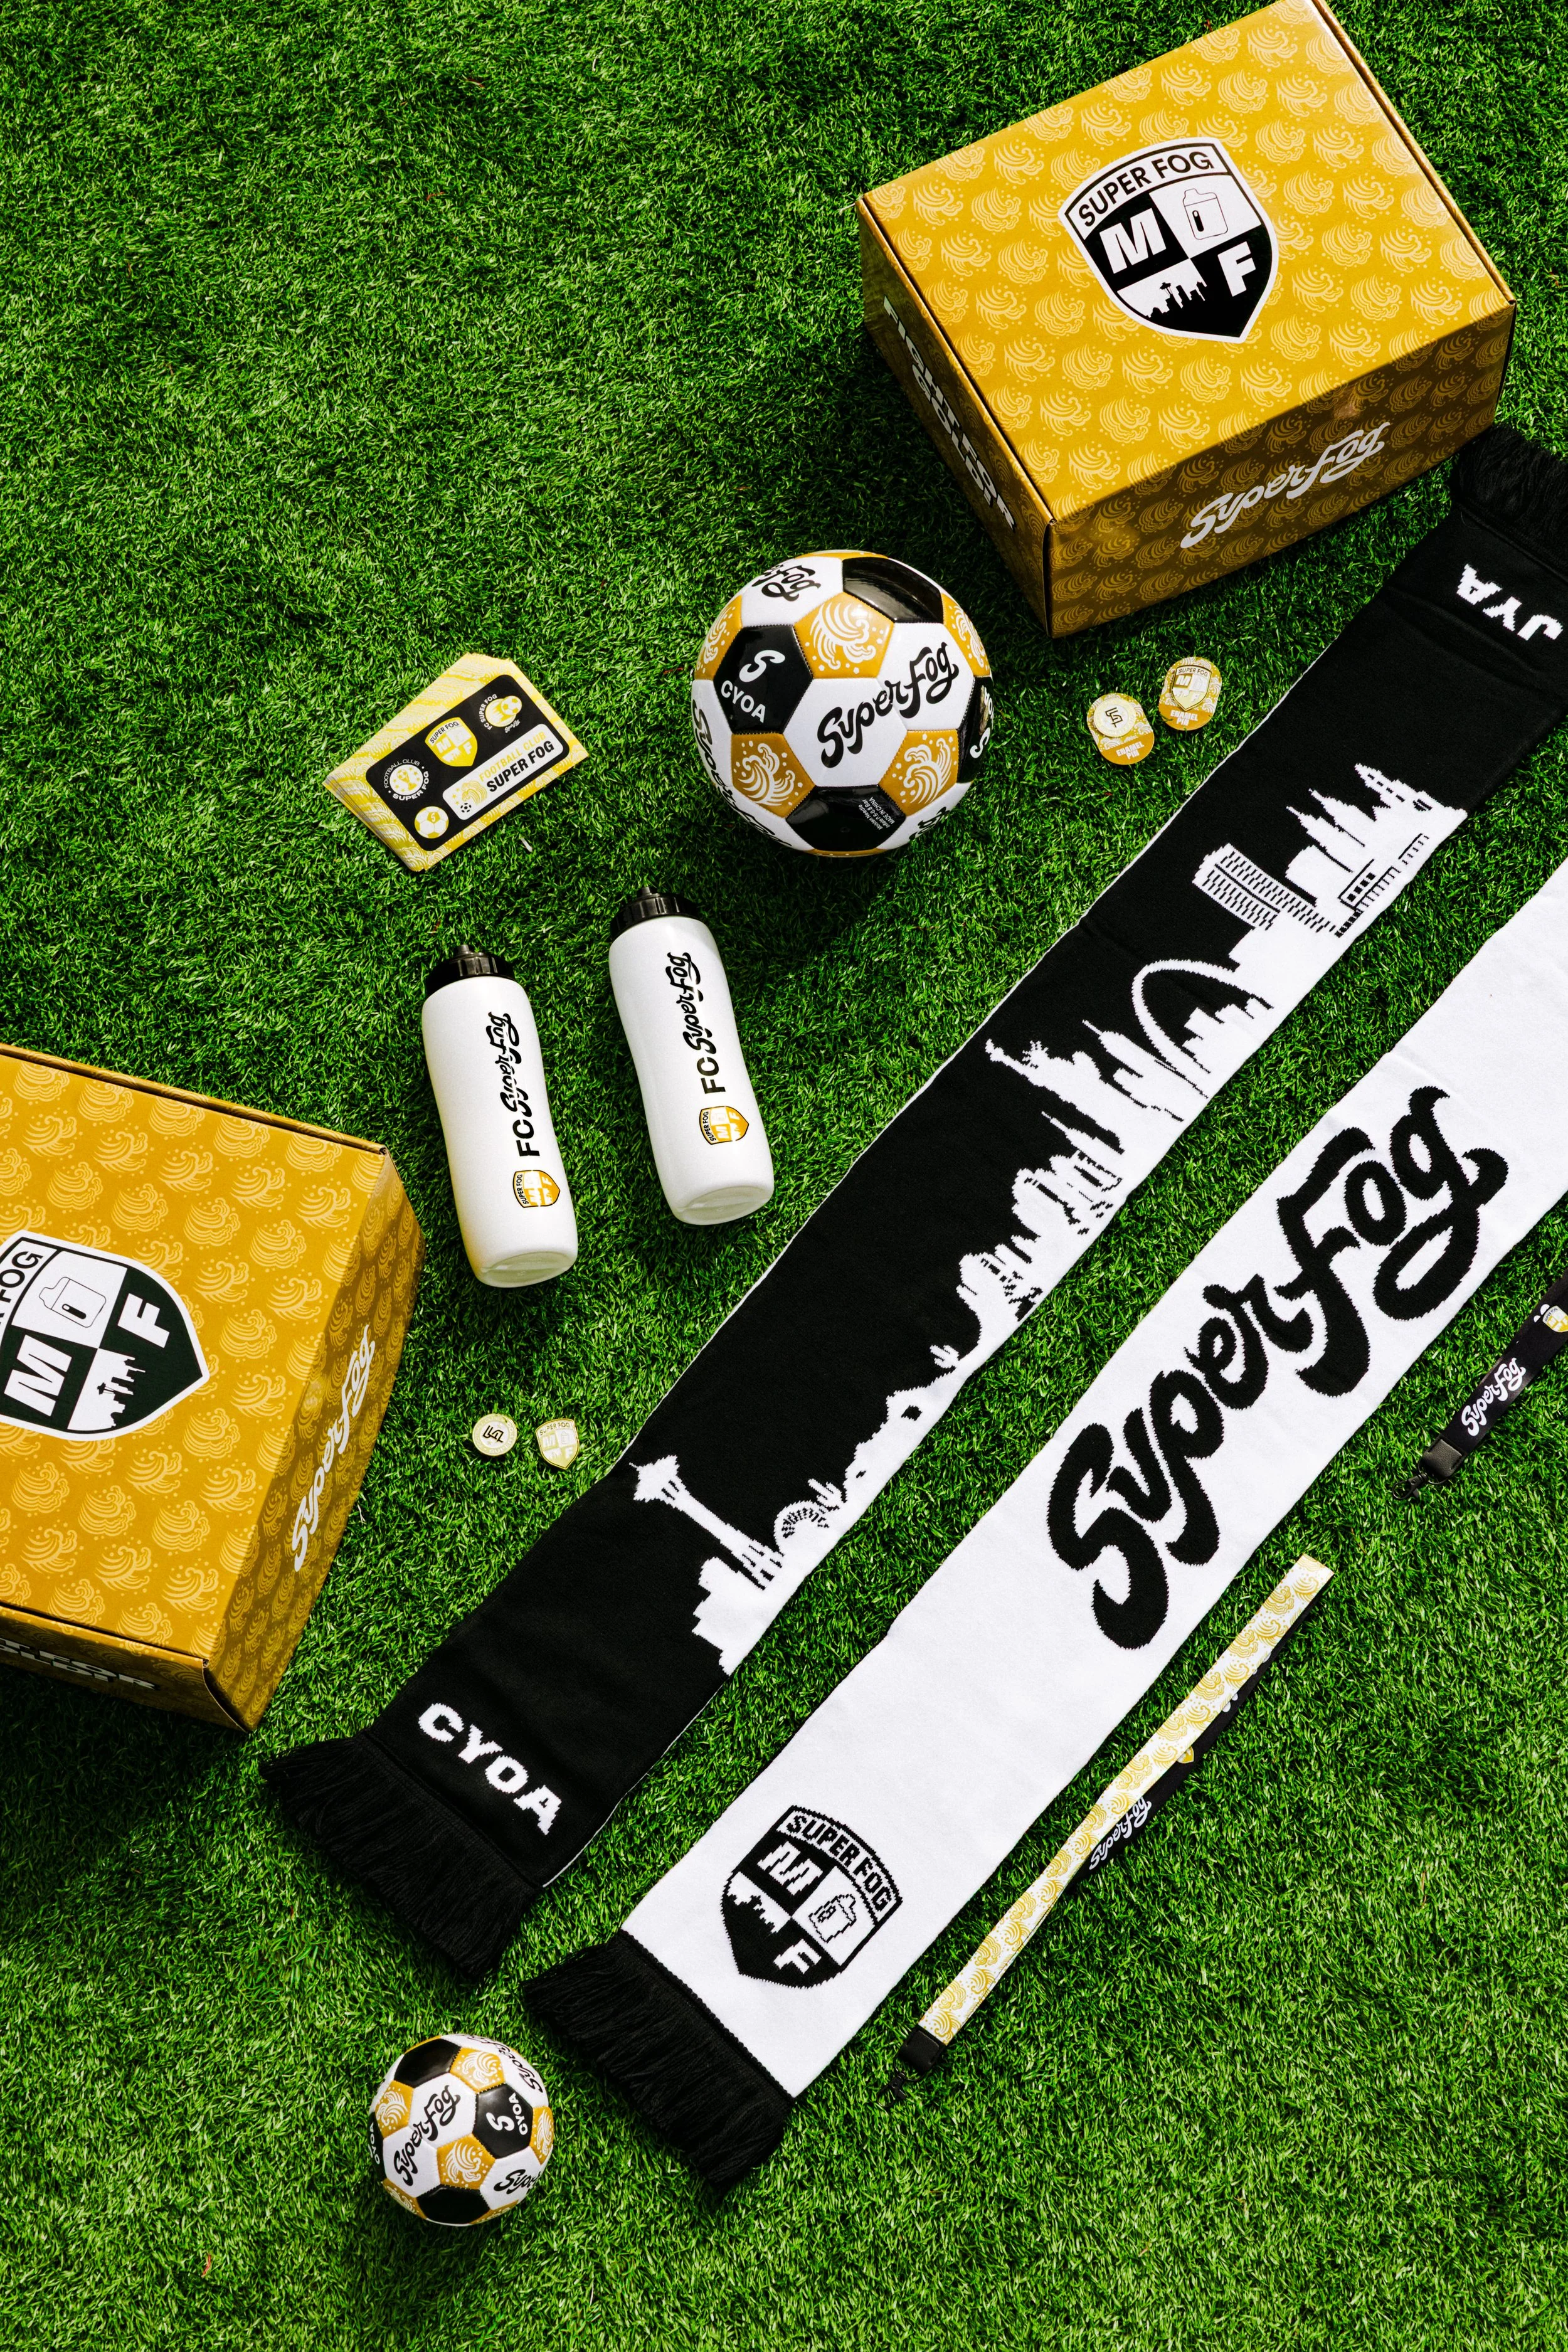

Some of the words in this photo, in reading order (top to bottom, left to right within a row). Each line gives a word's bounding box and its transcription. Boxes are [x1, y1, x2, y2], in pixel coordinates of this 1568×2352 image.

[1078, 166, 1152, 227] SUPER
[1151, 151, 1215, 179] FOG
[1099, 208, 1167, 274] M
[1217, 241, 1256, 297] F
[883, 295, 961, 428] FIGHT
[962, 432, 1015, 531] FOR
[912, 364, 992, 506] GOLD!
[1456, 563, 1564, 641] JYA
[739, 649, 785, 684] S
[1175, 674, 1192, 686] M
[1197, 669, 1209, 677] FOG
[479, 703, 487, 723] SUPER
[484, 694, 498, 704] FOG
[721, 680, 767, 723] CYOA
[484, 722, 493, 731] FC
[1170, 709, 1199, 722] ENAMEL
[1176, 717, 1190, 726] PIN
[430, 727, 445, 744] SUPER
[445, 721, 460, 730] FOG
[435, 736, 452, 753] M
[479, 748, 522, 782] FOOTBALL
[522, 731, 547, 751] CLUB
[1115, 741, 1145, 757] ENAMEL
[1126, 749, 1140, 760] PIN
[383, 761, 402, 788] FOOTBALL
[402, 758, 420, 766] CLUB
[486, 758, 529, 792] SUPER
[527, 740, 554, 765] FOG
[392, 790, 424, 801] SUPER
[421, 771, 430, 790] FOG
[858, 804, 871, 819] Needle
[862, 799, 871, 808] Bar
[869, 797, 882, 812] CHINA
[882, 813, 896, 825] MADE
[696, 1056, 726, 1094] FC
[512, 1118, 541, 1157] FC
[703, 1124, 716, 1142] SUPER
[516, 1187, 529, 1205] SUPER
[117, 1292, 170, 1348] F
[3, 1334, 73, 1417] M
[539, 1423, 557, 1436] SUPER
[418, 1702, 562, 1836] CYOA
[756, 1840, 824, 1897] M
[785, 1815, 861, 1868] SUPER
[852, 1857, 893, 1913] FOG
[773, 1938, 822, 1974] F
[485, 2111, 515, 2132] S
[508, 2092, 528, 2136] CYOA
